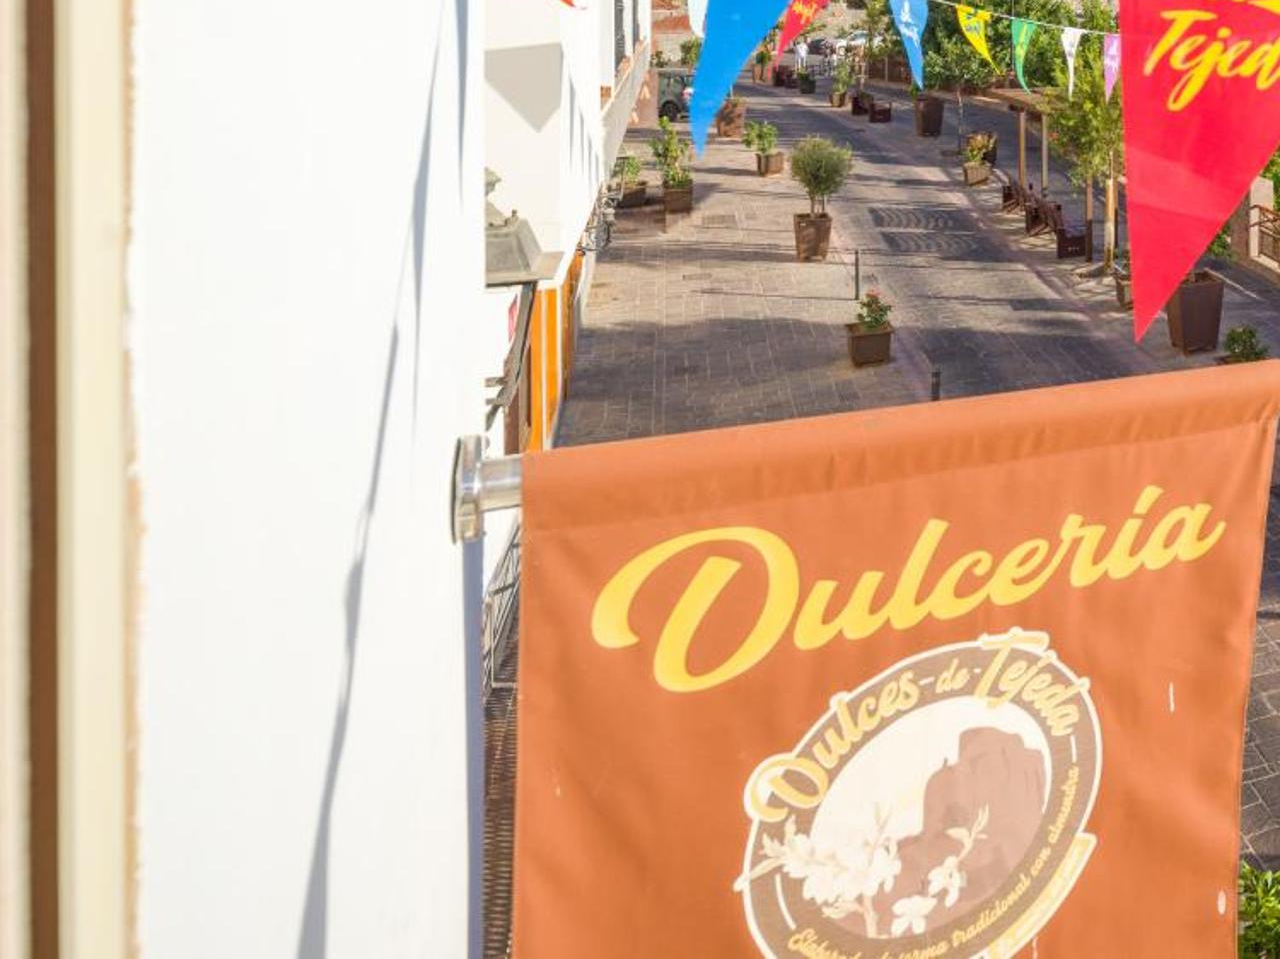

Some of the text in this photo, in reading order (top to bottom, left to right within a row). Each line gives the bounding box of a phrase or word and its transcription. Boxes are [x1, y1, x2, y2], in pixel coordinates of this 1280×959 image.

[591, 485, 1226, 693] Dulcería
[750, 668, 922, 822] Dulces
[974, 630, 1088, 737] Tejeda
[952, 872, 1031, 948] tradicional
[1030, 846, 1051, 877] con
